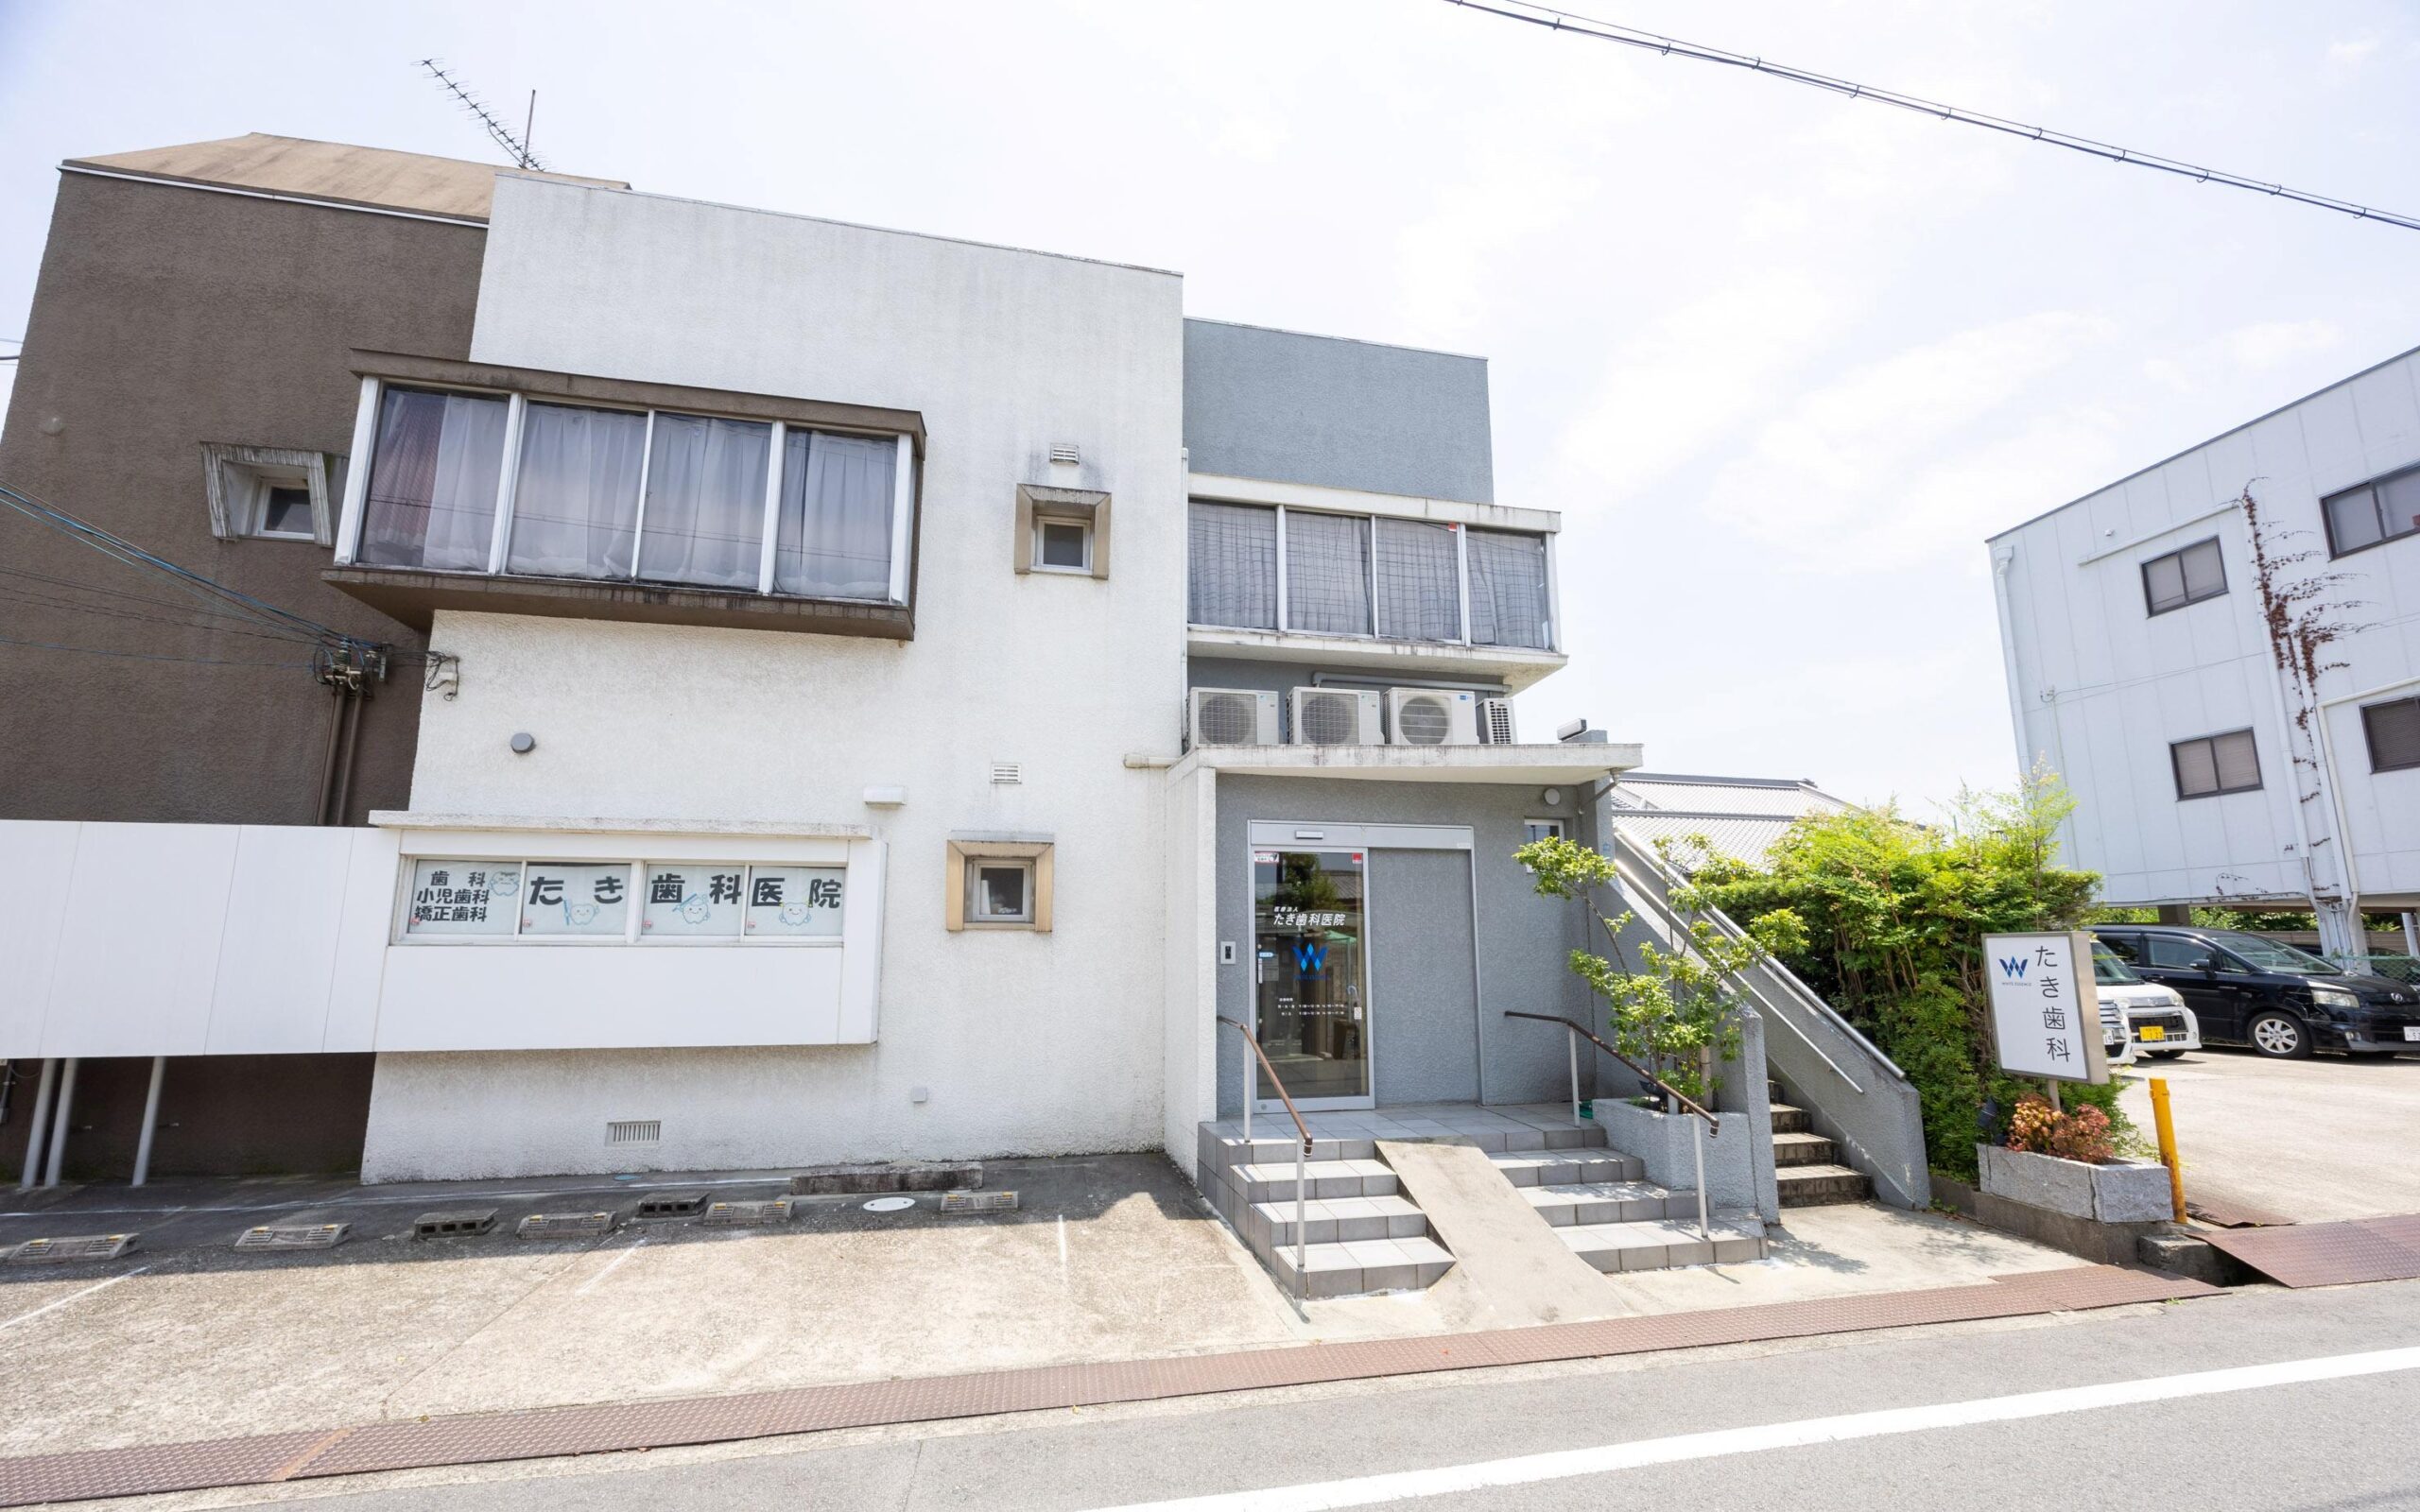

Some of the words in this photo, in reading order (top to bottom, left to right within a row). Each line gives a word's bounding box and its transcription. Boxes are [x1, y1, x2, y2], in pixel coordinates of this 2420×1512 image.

[430, 870, 486, 887] 歯科
[416, 887, 490, 904] 小児歯科
[414, 905, 487, 922] 矯正歯科
[1273, 913, 1346, 926] たき歯科医院
[2035, 945, 2071, 1062] たき歯科
